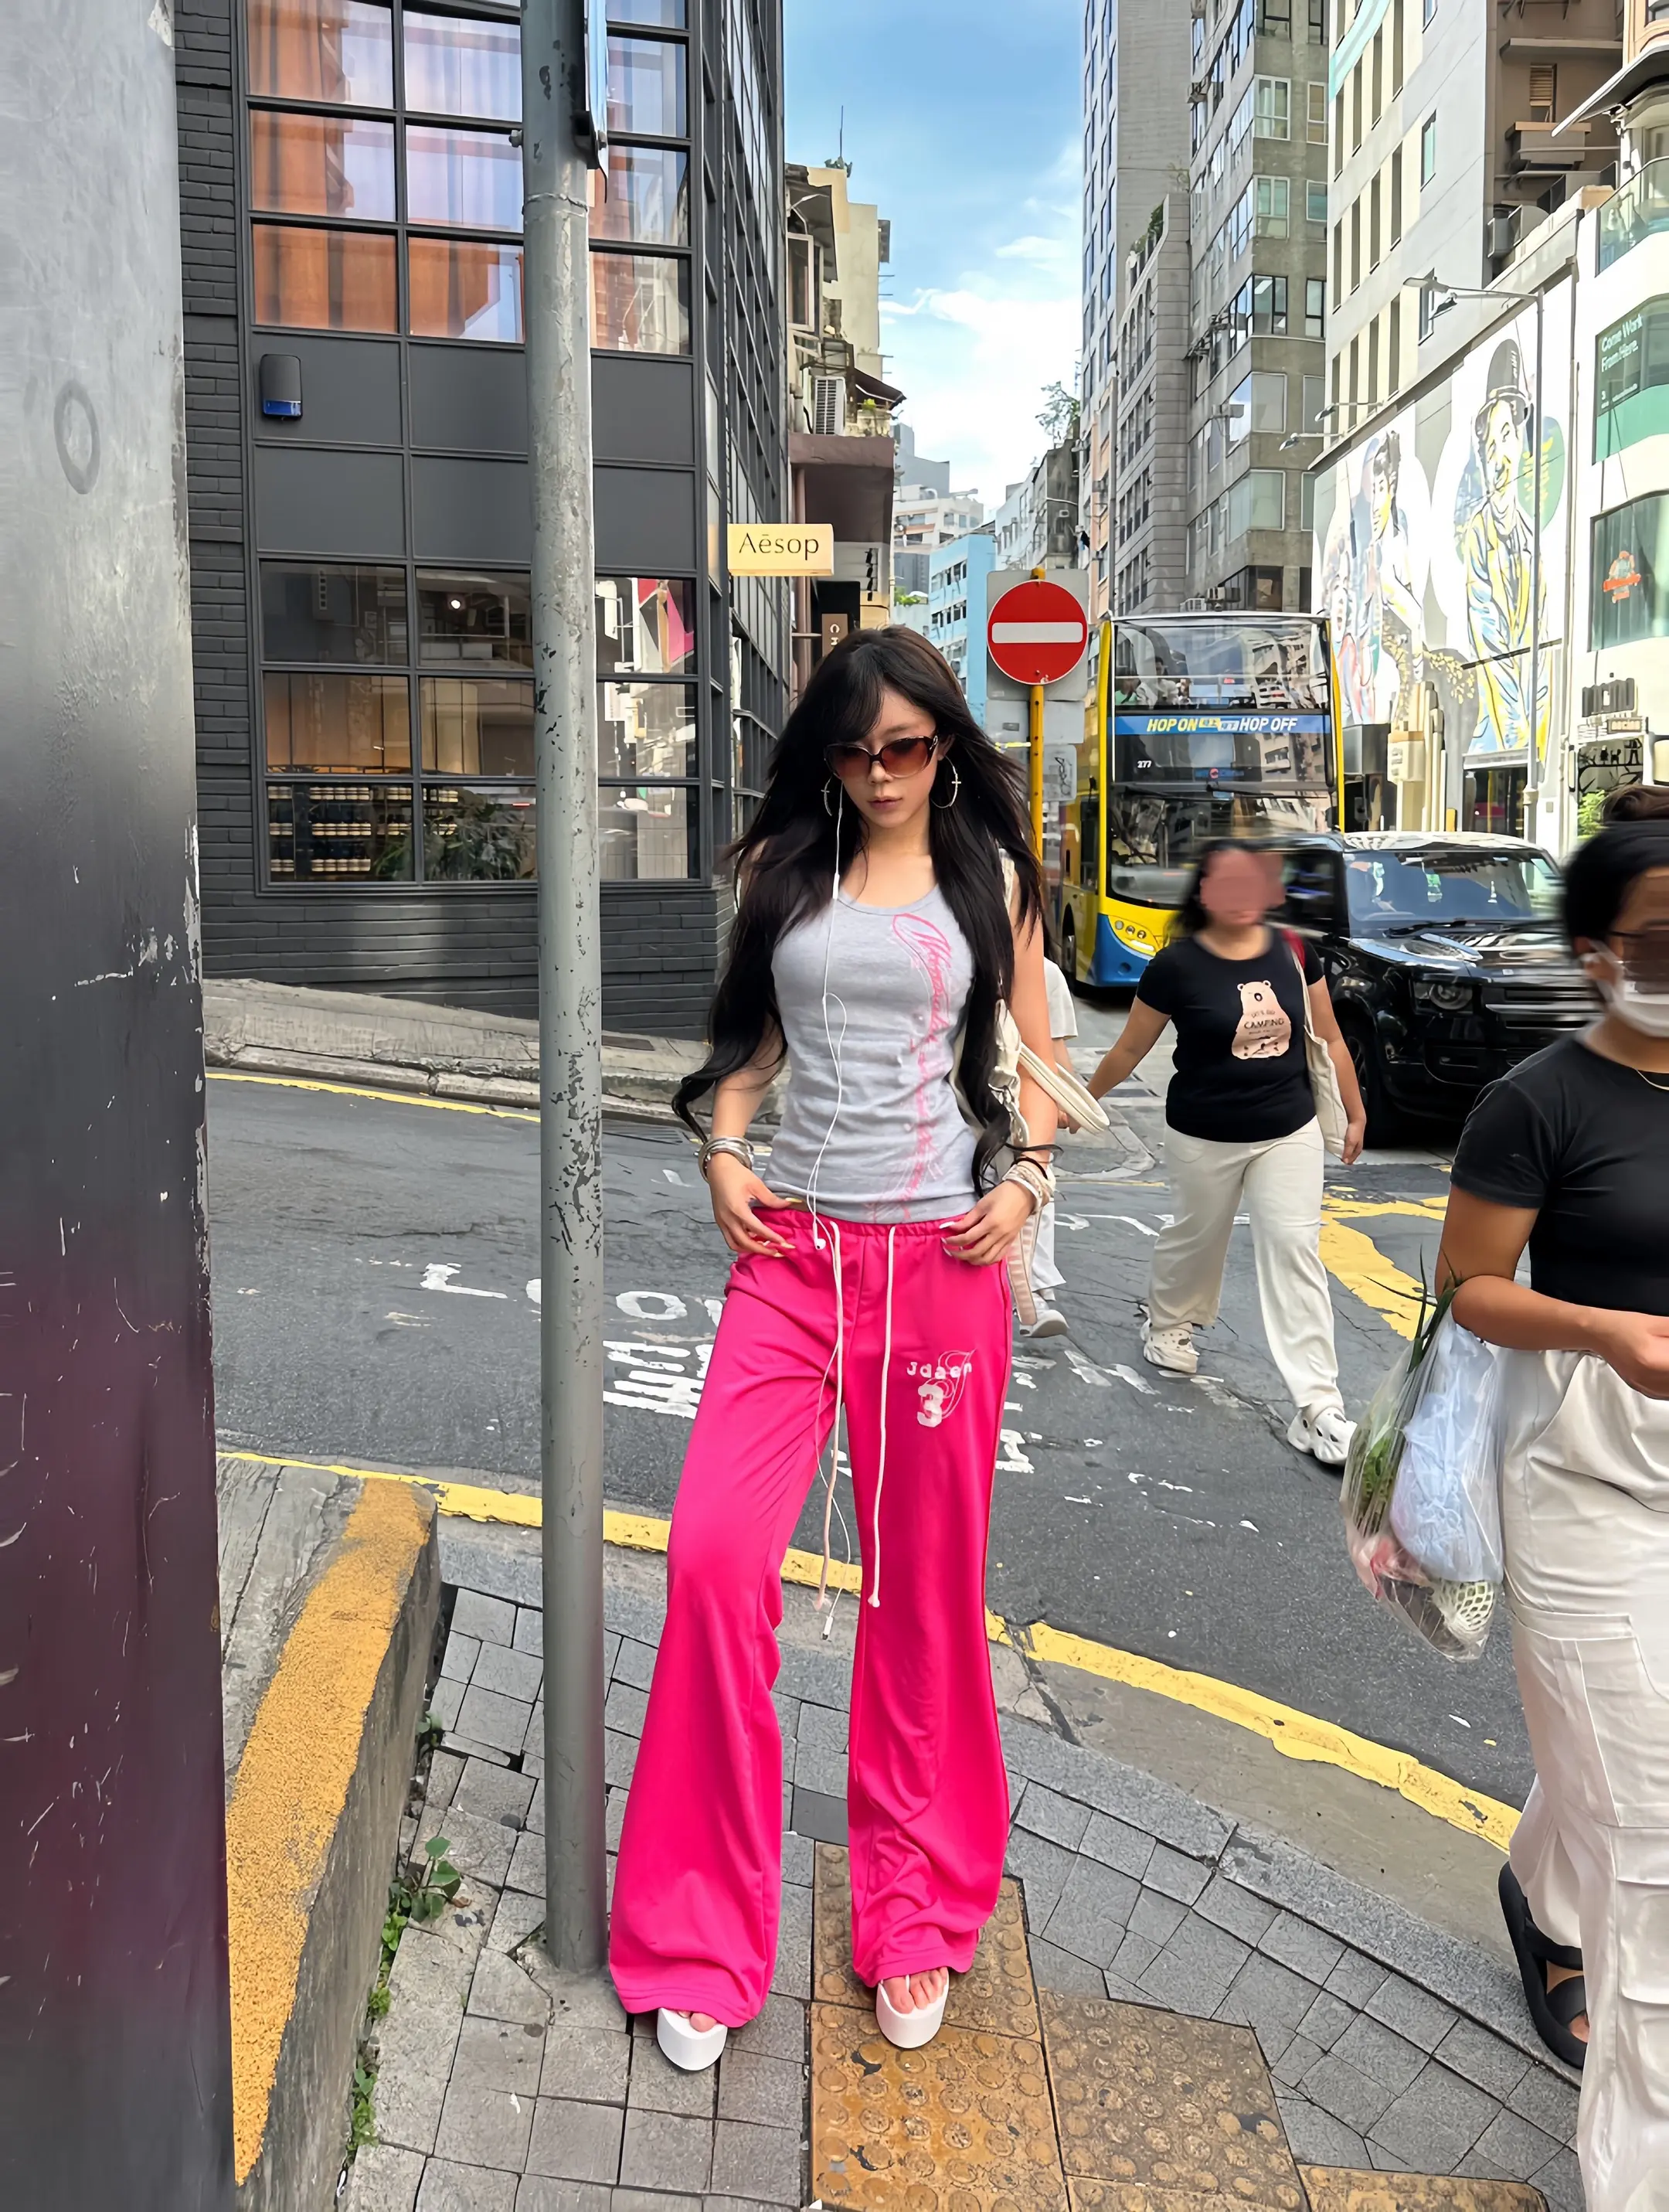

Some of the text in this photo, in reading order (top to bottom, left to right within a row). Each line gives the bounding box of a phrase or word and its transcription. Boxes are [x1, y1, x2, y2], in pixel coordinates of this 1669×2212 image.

[1147, 719, 1178, 732] HOP
[1178, 718, 1198, 731] ON
[1239, 717, 1269, 731] HOP
[1270, 717, 1298, 731] OFF
[916, 1383, 944, 1428] 3
